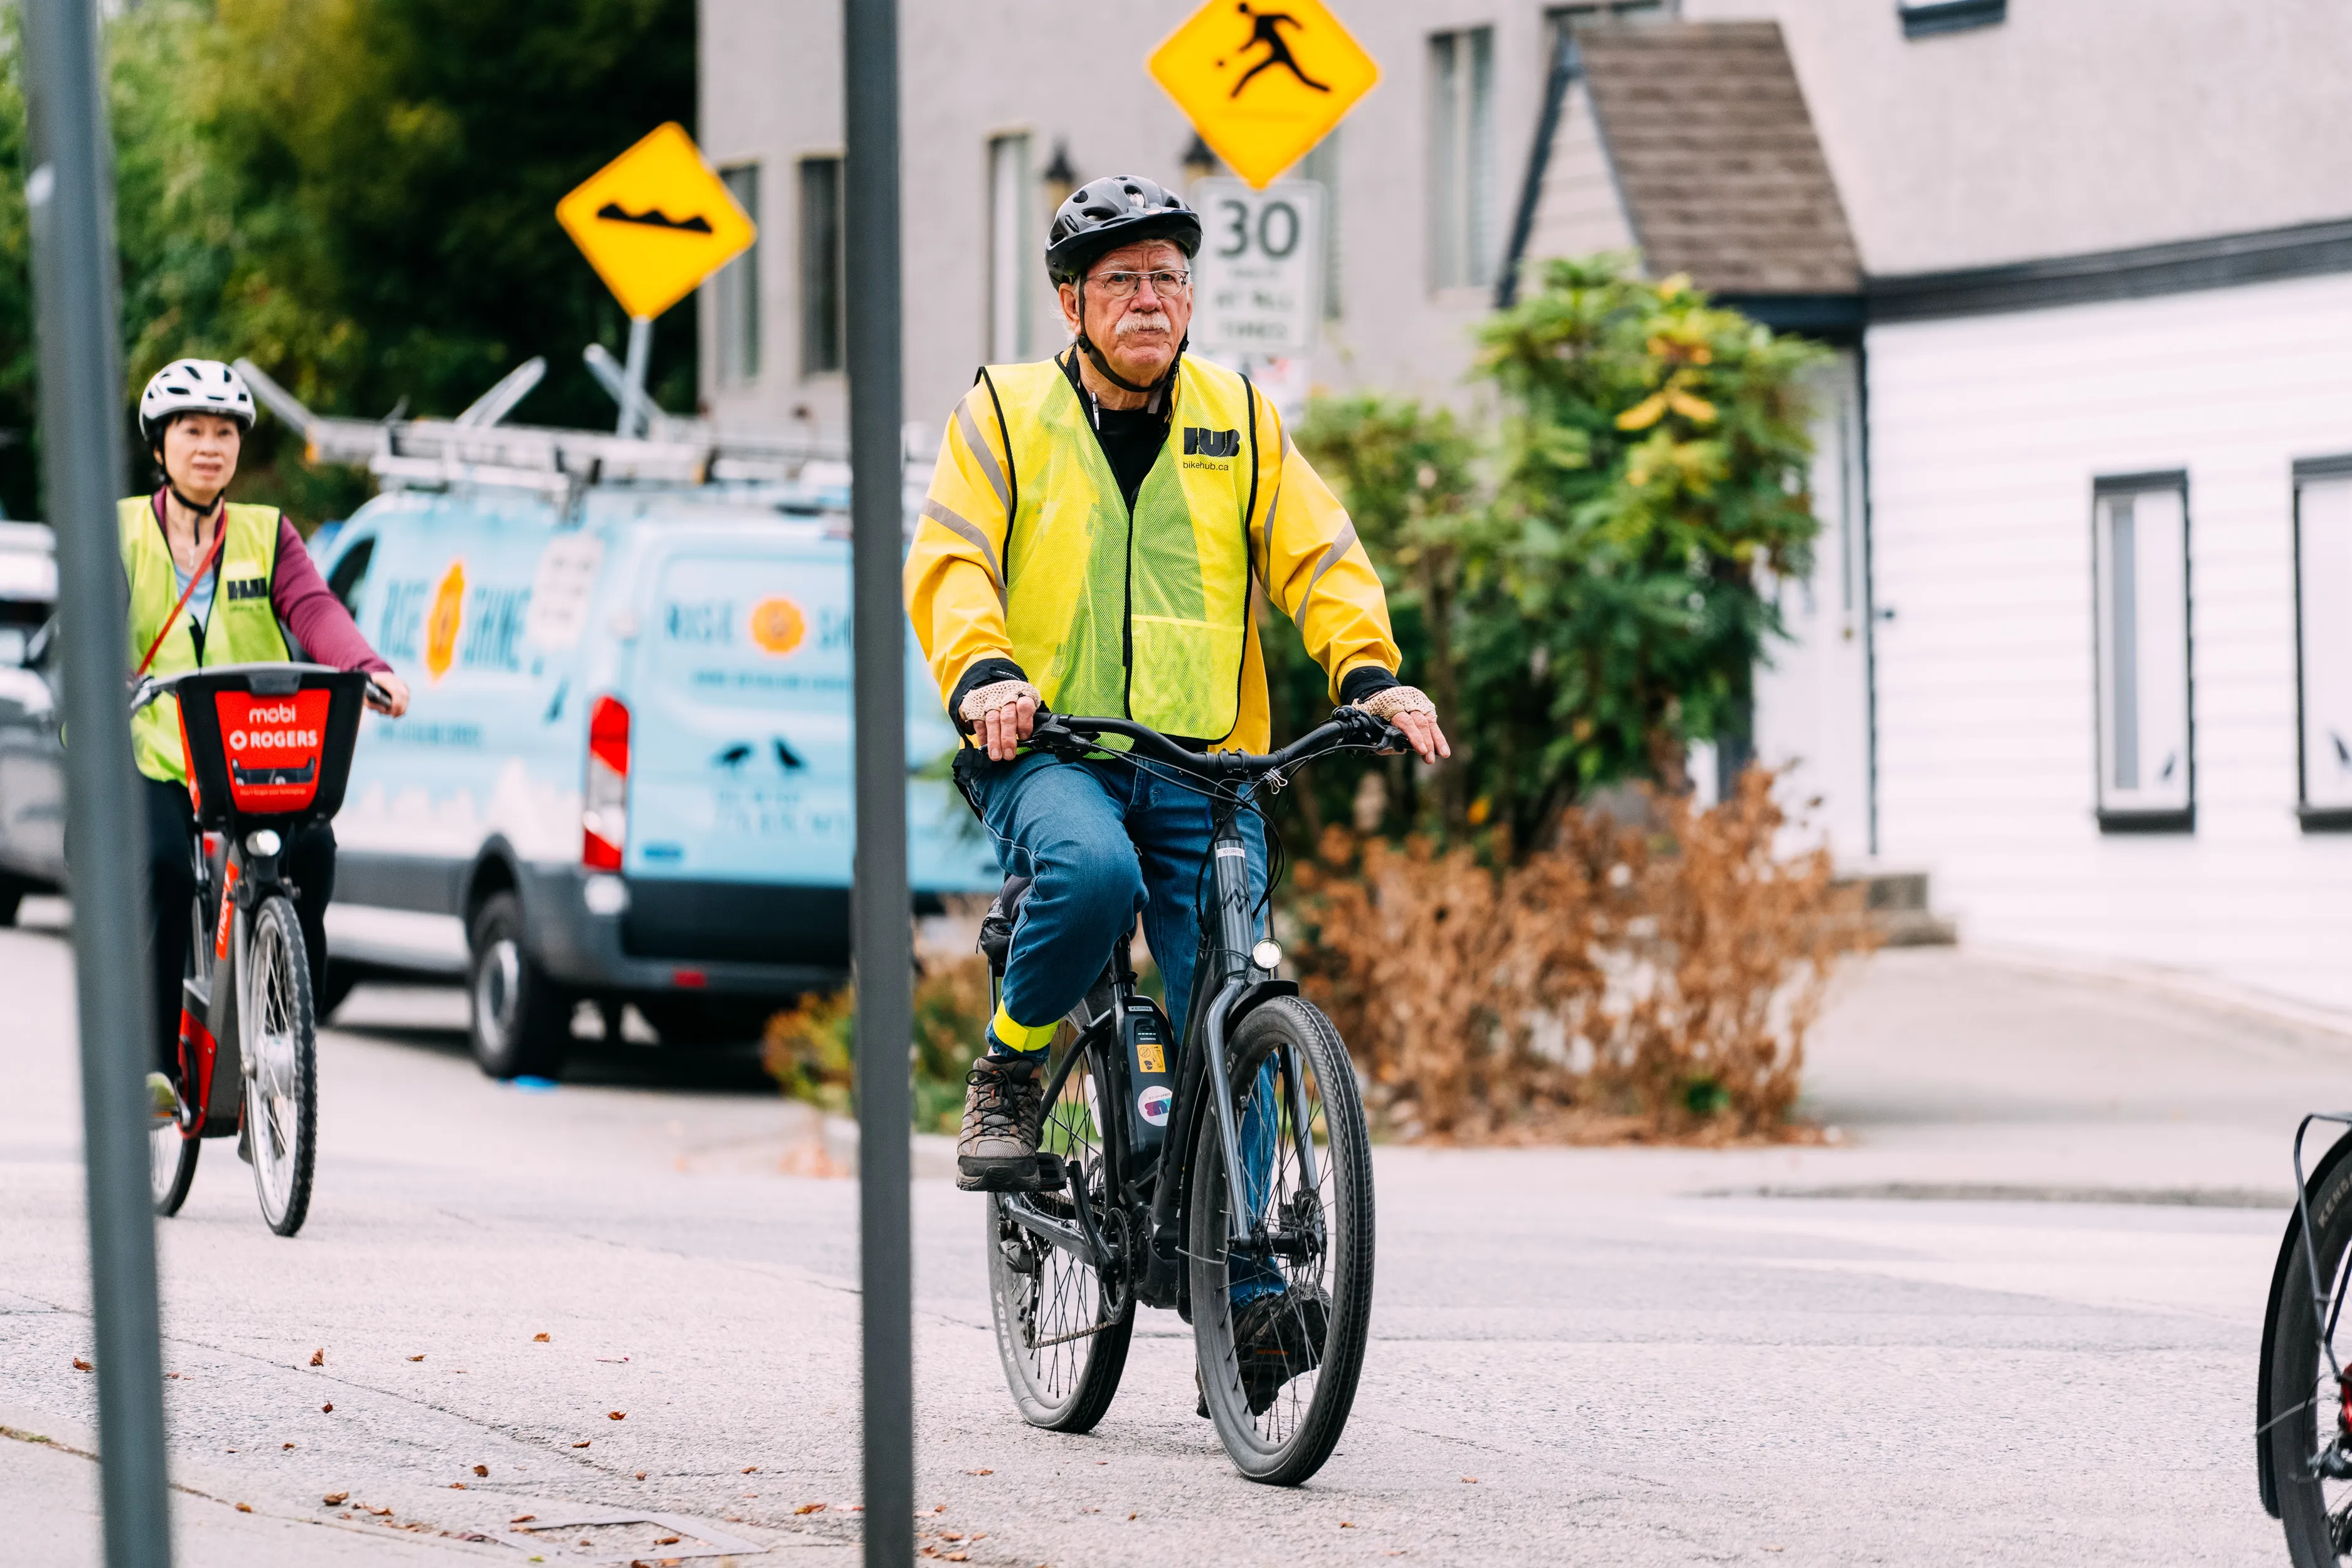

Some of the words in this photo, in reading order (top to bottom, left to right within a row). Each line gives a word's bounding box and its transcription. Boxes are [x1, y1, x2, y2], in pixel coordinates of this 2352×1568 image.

[1216, 198, 1300, 262] 30
[1183, 427, 1241, 457] HUB
[1183, 461, 1229, 470] bikehub.ca
[249, 702, 296, 724] mobi
[250, 729, 318, 748] ROGERS
[996, 1291, 1015, 1363] KENDA
